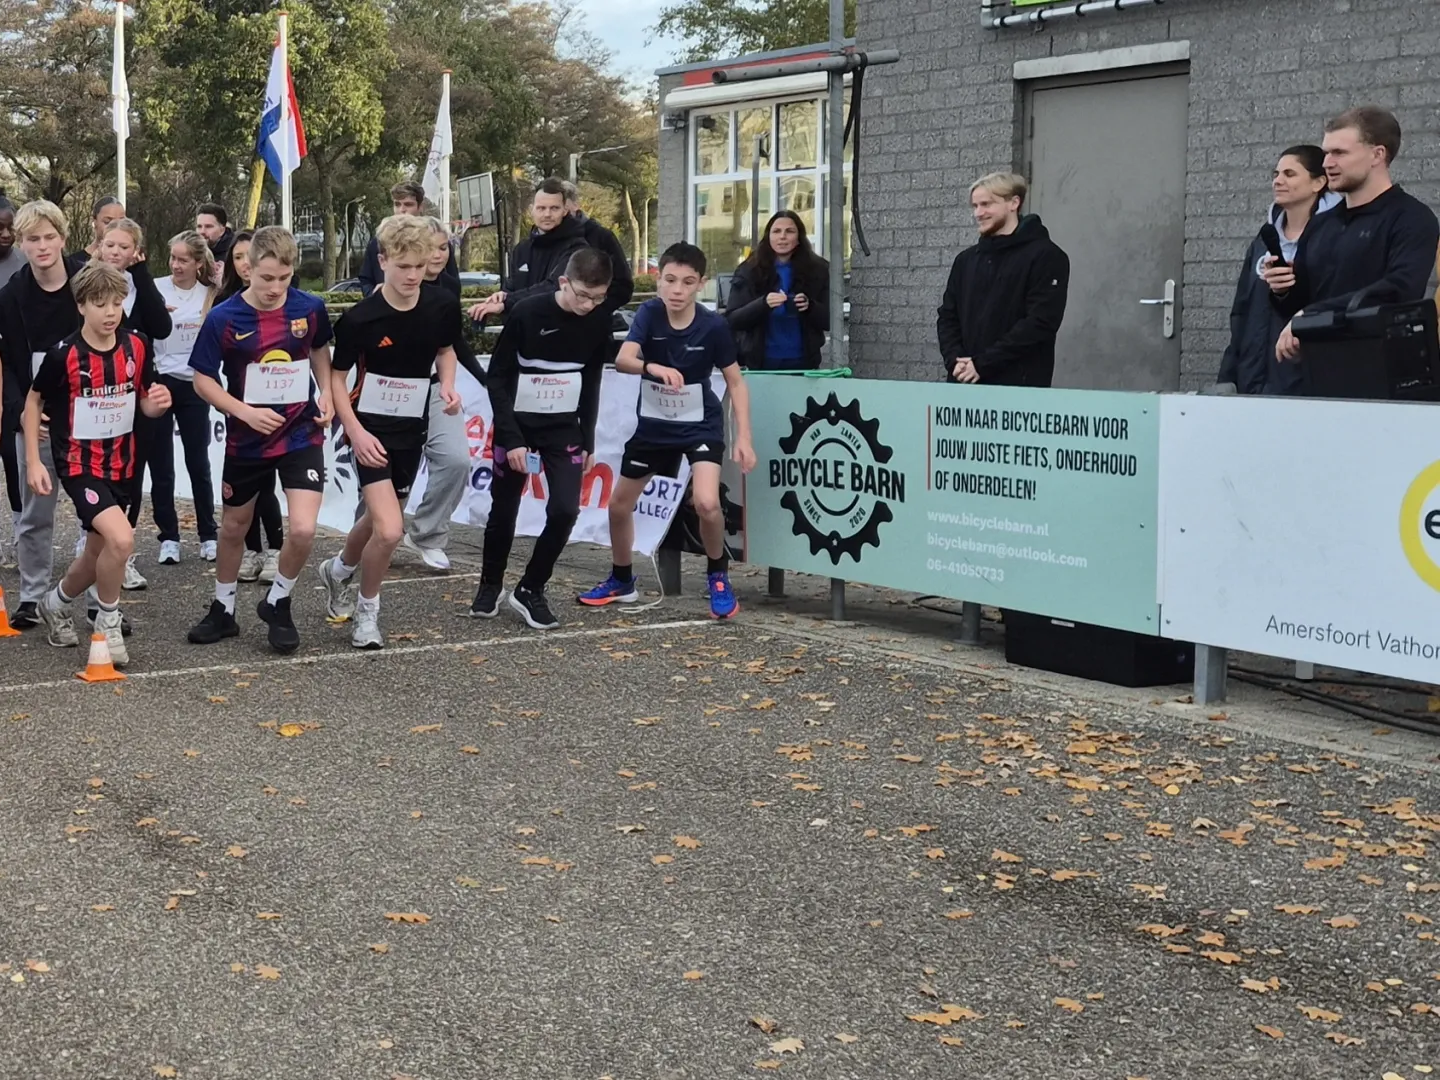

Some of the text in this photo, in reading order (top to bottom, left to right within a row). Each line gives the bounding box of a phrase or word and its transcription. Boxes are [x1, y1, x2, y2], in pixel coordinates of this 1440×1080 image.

[82, 381, 135, 398] Emirates
[265, 379, 295, 389] 1137
[535, 389, 565, 400] 1113
[380, 391, 410, 403] 1115
[658, 398, 686, 408] 1111
[93, 412, 123, 424] 1135
[935, 406, 1129, 440] KOM NAAR BICYCLEBARN VOOR
[810, 427, 822, 442] VAN
[935, 438, 1138, 477] JOUW JUISTE FIETS, ONDERHOUD
[642, 479, 683, 502] ORT
[768, 457, 906, 504] BICYCLE BARN
[935, 469, 1037, 501] OF ONDERDELEN!
[803, 498, 867, 529] SINCE 2020
[926, 510, 1050, 537] www.bicyclebarn.nl
[926, 532, 1089, 569] bicyclebarn@outlook.com
[926, 558, 1005, 582] 06-41050733
[1265, 614, 1372, 649] Amersfoort
